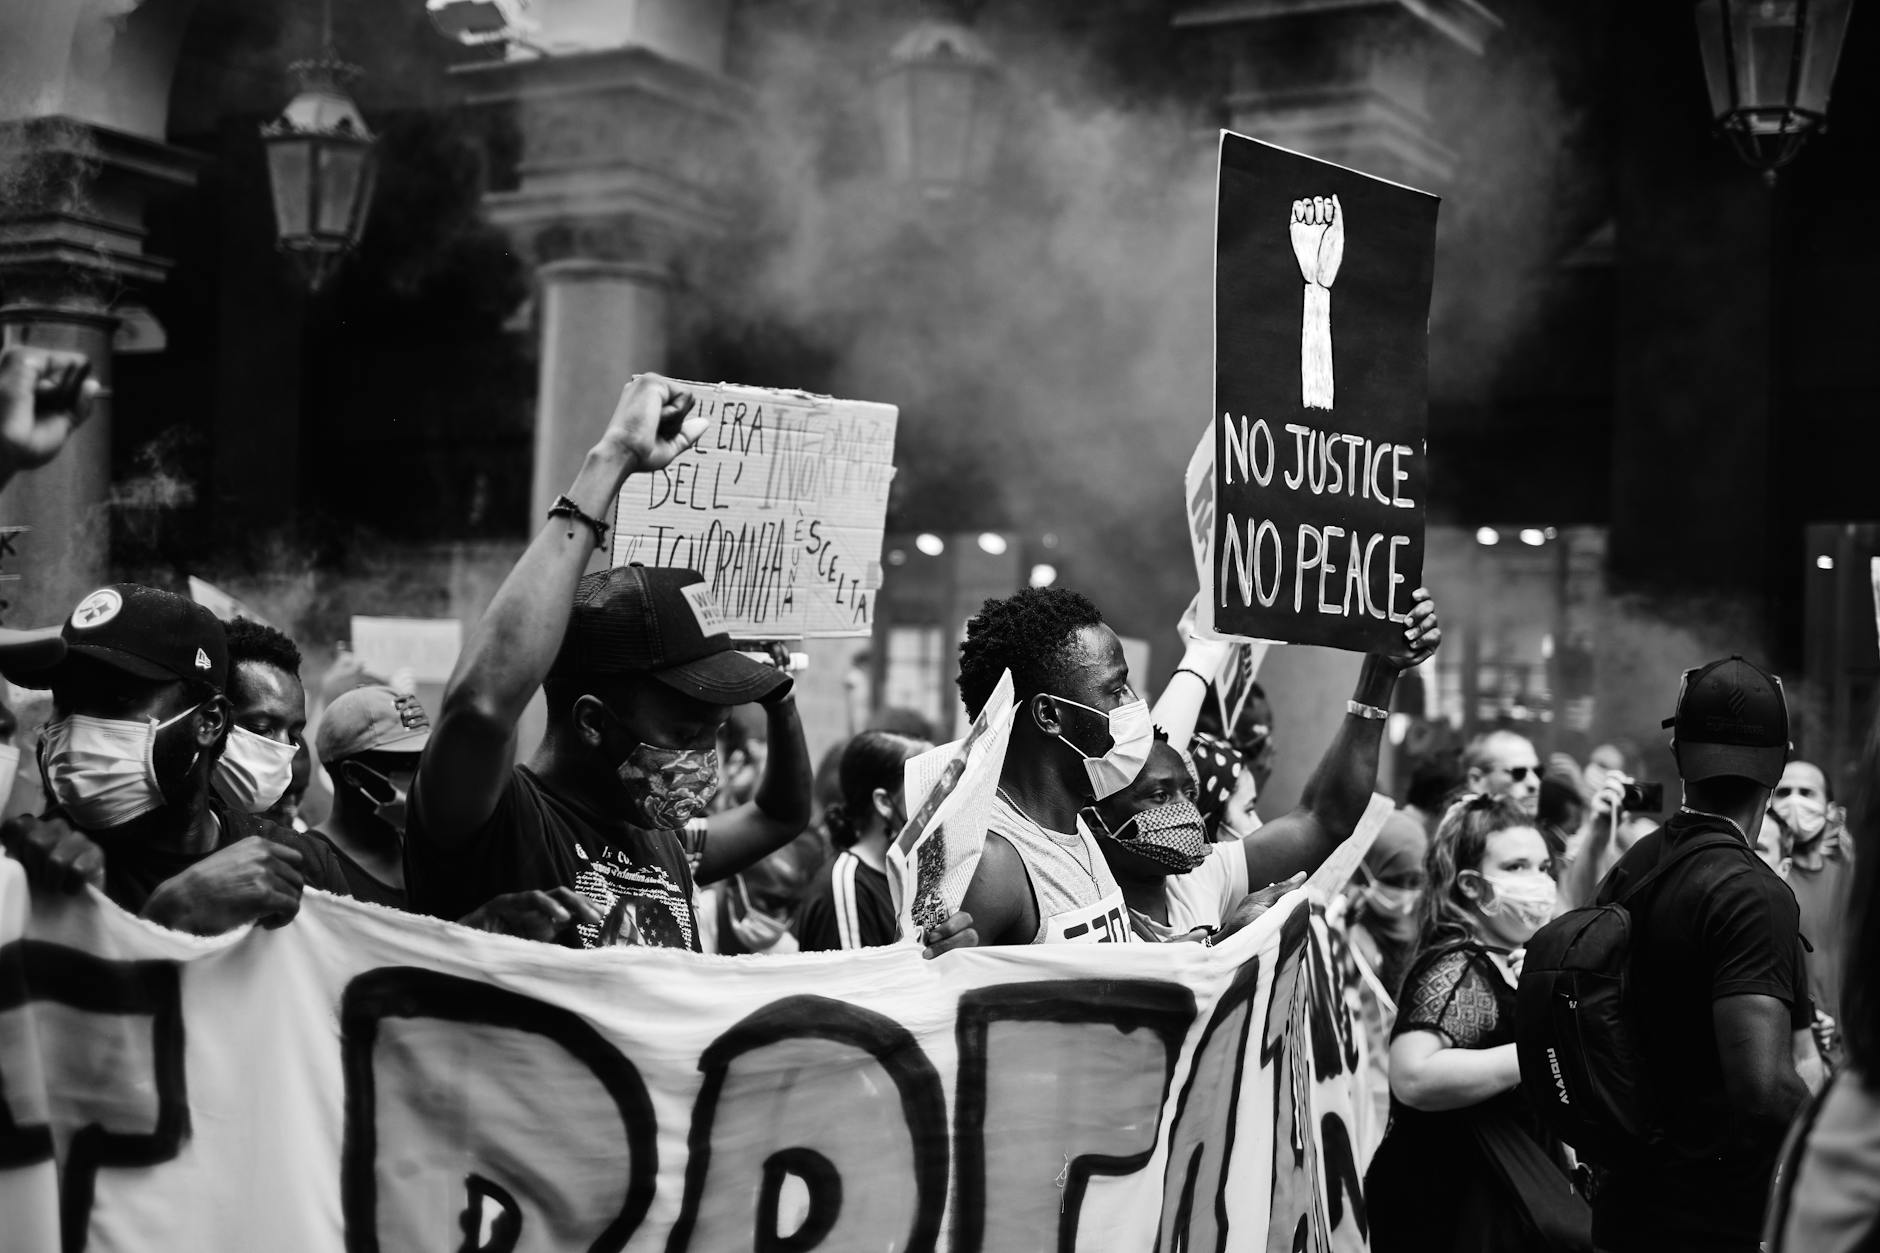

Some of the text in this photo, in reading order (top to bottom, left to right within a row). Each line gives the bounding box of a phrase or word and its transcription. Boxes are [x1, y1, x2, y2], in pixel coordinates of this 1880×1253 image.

[648, 461, 743, 511] DELL'
[1224, 411, 1415, 508] NO JUSTICE
[806, 519, 868, 625] SCELTA
[1221, 512, 1411, 624] NO PEACE
